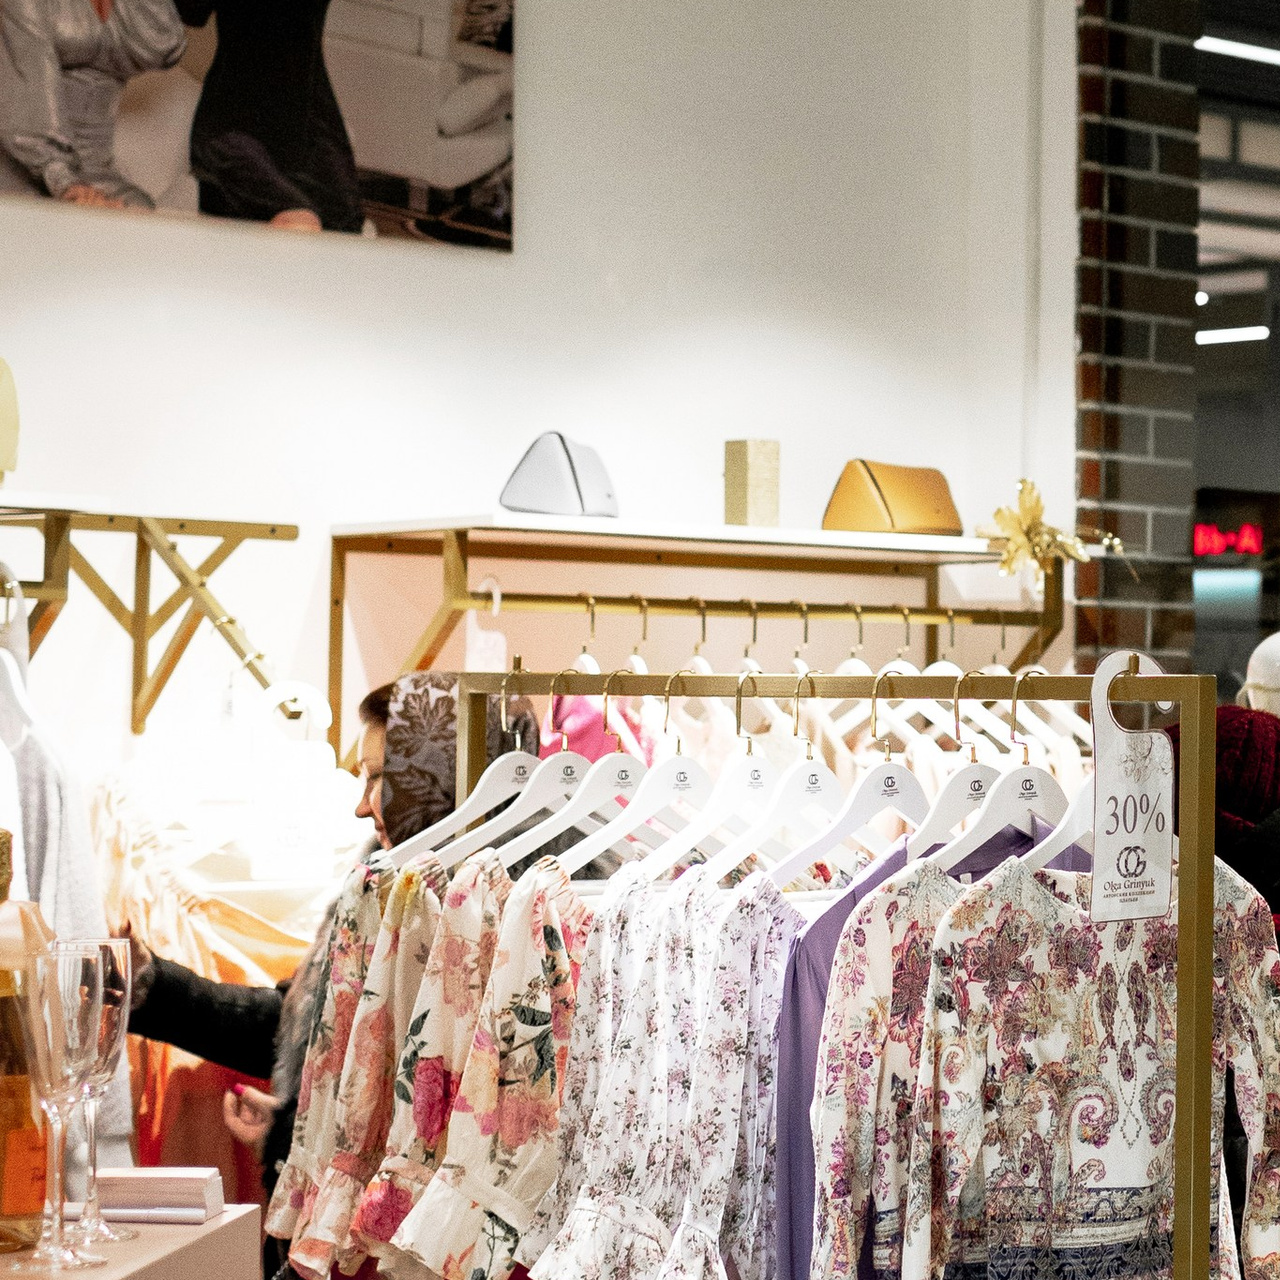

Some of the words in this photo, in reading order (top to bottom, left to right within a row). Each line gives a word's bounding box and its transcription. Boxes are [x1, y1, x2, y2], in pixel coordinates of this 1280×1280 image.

[1105, 793, 1165, 836] 30%
[1103, 880, 1122, 892] Olga
[1123, 877, 1156, 890] Grinyuk
